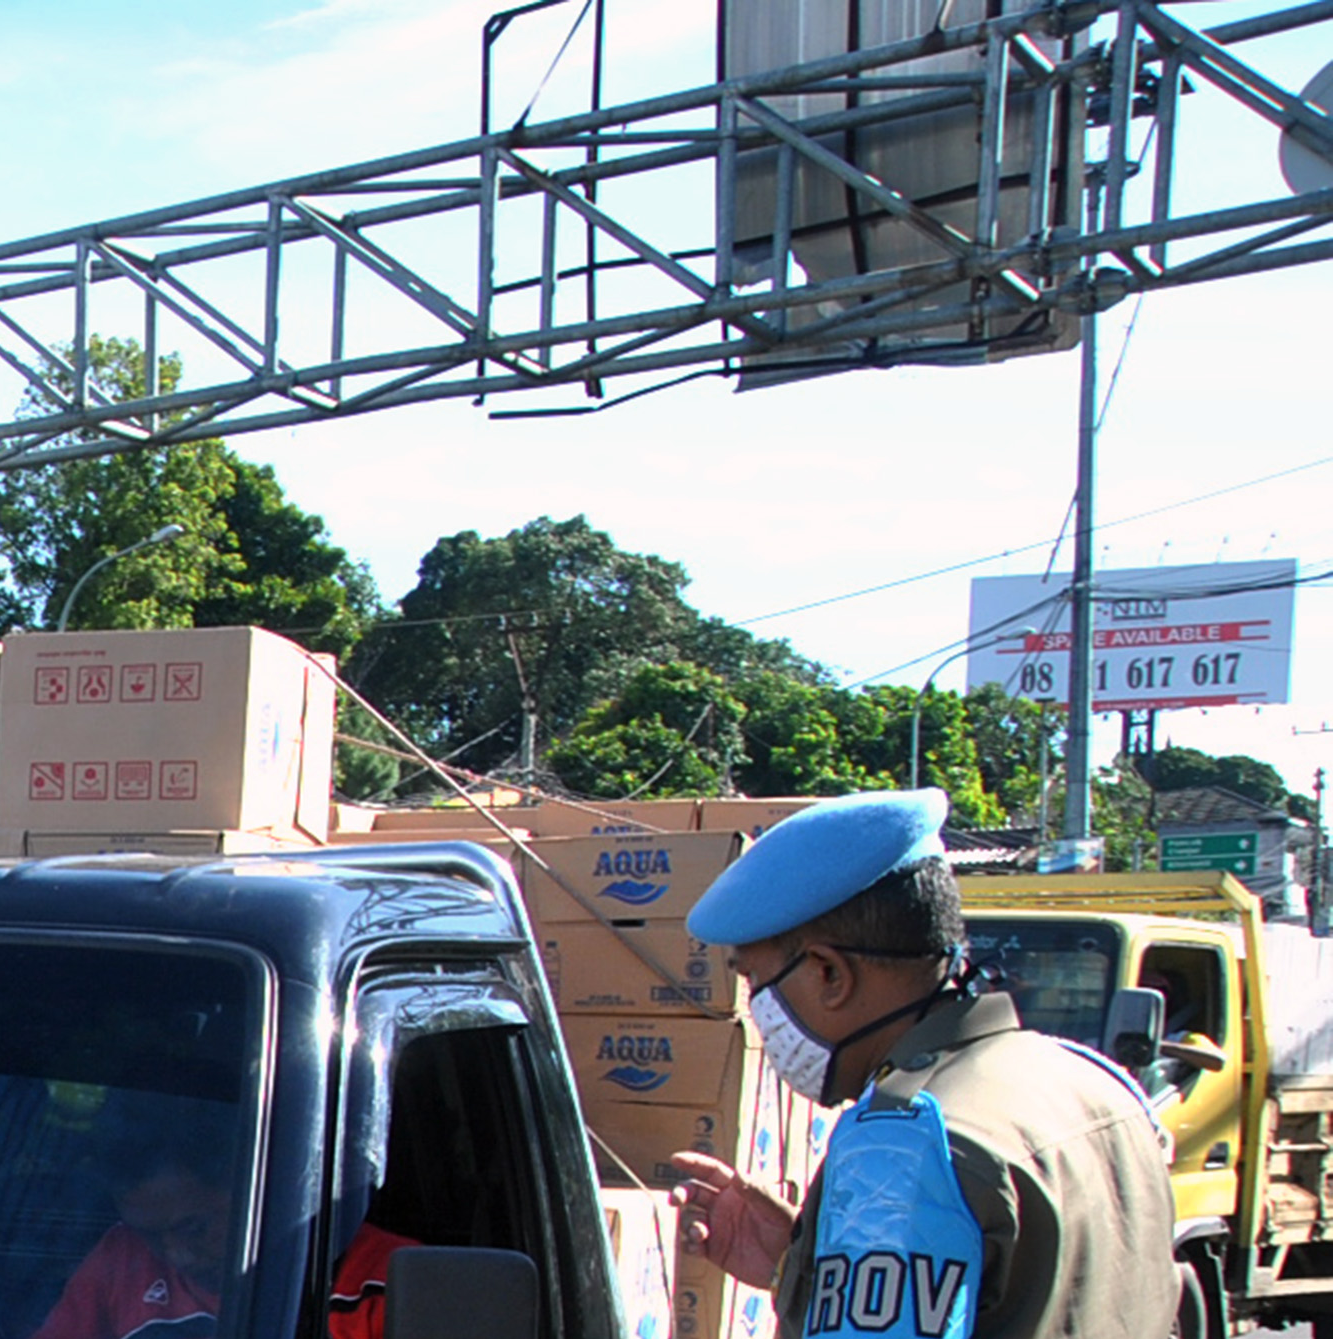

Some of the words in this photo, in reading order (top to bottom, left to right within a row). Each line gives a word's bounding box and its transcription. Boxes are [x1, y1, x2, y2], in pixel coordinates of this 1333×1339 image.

[1042, 631, 1106, 650] SPE
[1110, 625, 1221, 646] AVAILABLE
[1020, 662, 1054, 693] 08
[1126, 656, 1176, 690] 617
[1191, 652, 1242, 687] 617
[592, 849, 672, 880] AQUA
[595, 1035, 674, 1067] AQUA
[808, 1251, 967, 1339] ROV
